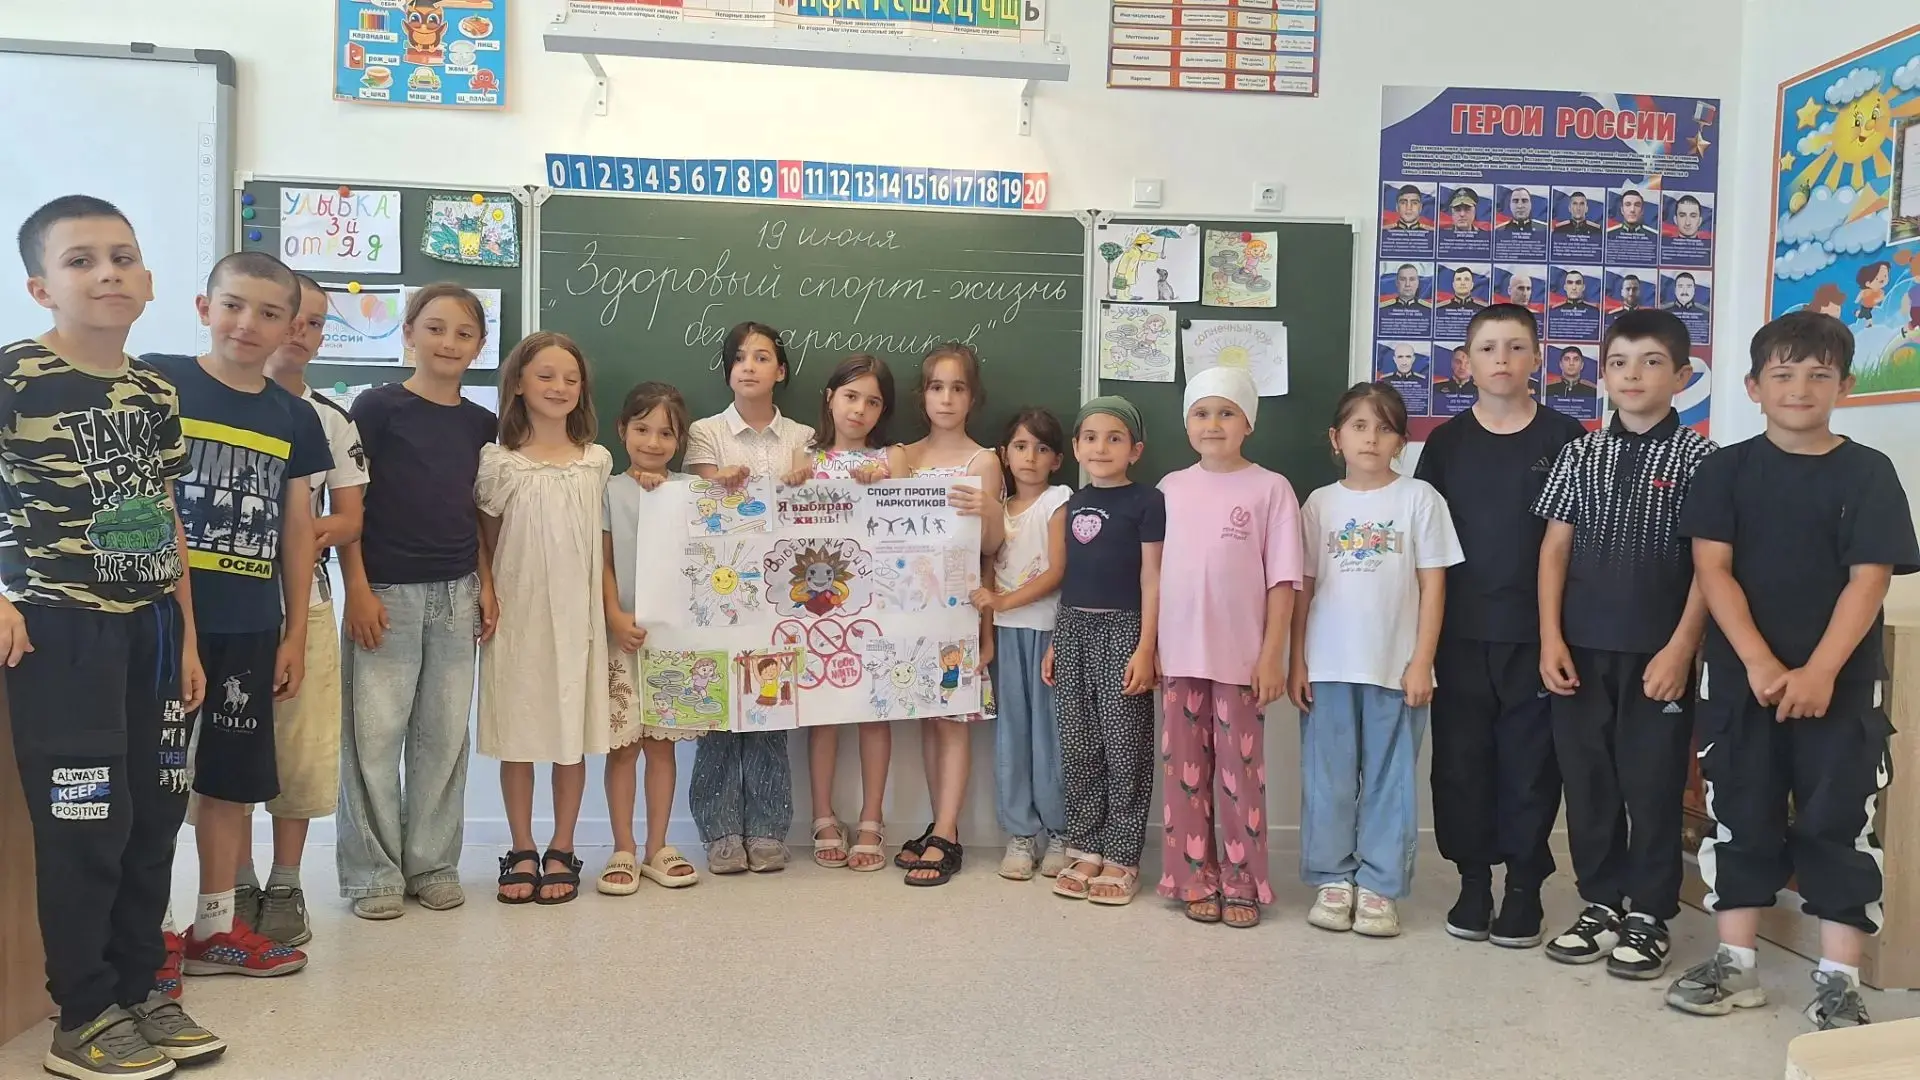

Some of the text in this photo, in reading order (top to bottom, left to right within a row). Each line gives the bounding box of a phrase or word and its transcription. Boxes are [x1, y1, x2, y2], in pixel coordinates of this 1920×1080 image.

[1451, 103, 1676, 142] ГЕРОИ РОССИИ
[551, 160, 1046, 204] 0 1 2 3 4 5 6 7 8 9 10 11 12 13 14 15 16 17 18 19 20
[757, 220, 901, 250] 19 июня
[323, 333, 363, 342] ОССИИ
[177, 438, 287, 501] UMMER
[867, 487, 946, 496] СПОРТ ПРОТИВ
[777, 501, 853, 515] Я выбираю
[876, 499, 946, 507] НАРКОТИКОВ
[792, 514, 839, 525] жизнь!
[218, 557, 270, 576] OCEAN
[212, 712, 258, 730] POLO
[57, 768, 105, 781] ALWAYS
[58, 783, 97, 801] KEEP
[55, 804, 107, 817] POSITIVE
[206, 901, 219, 911] 23
